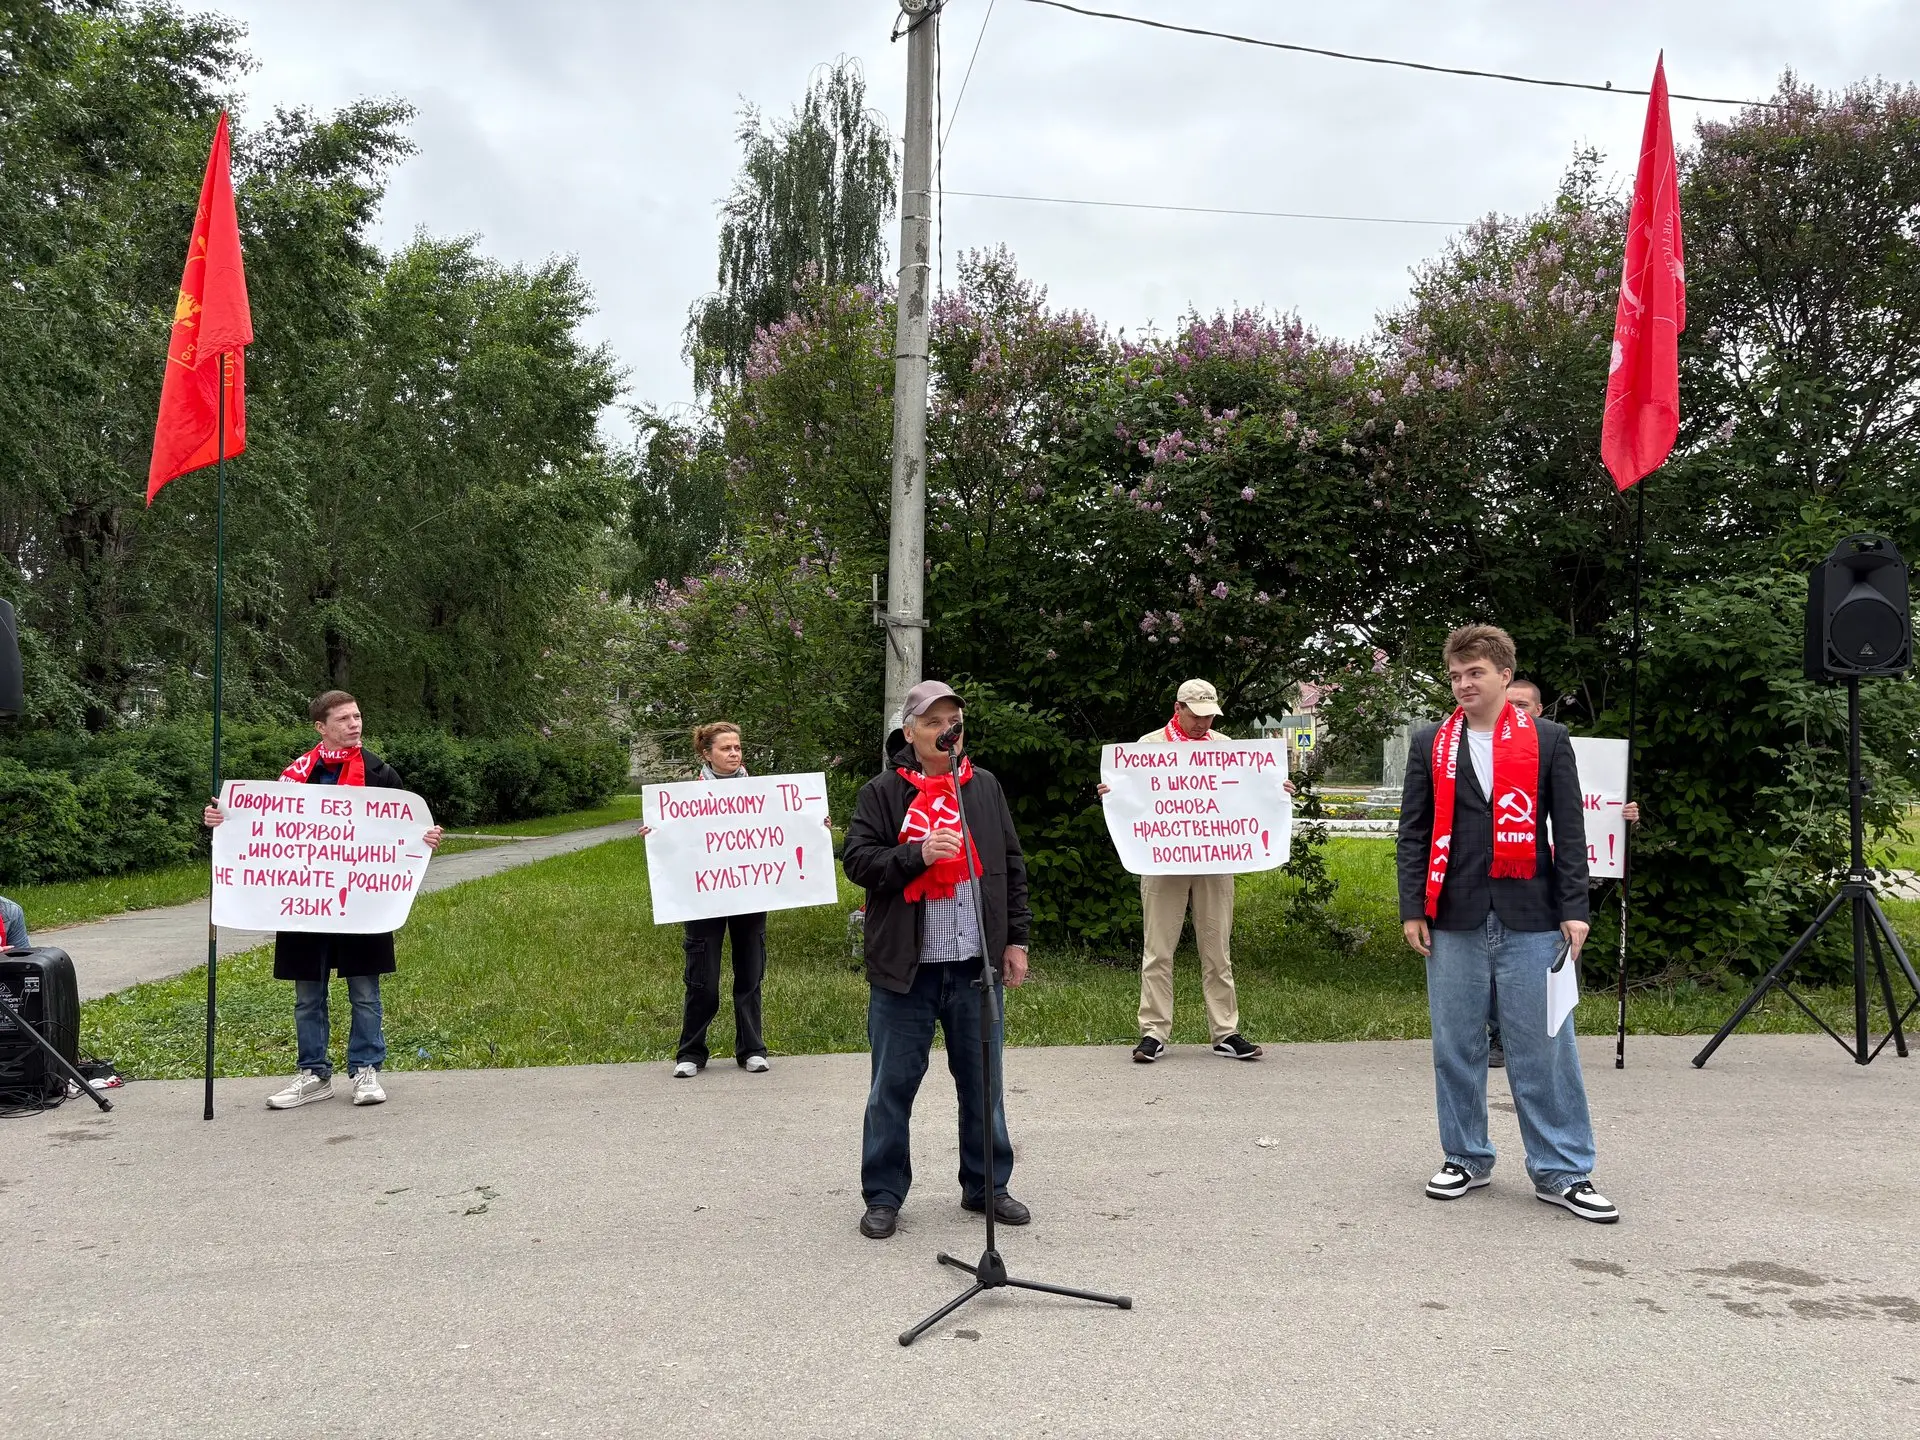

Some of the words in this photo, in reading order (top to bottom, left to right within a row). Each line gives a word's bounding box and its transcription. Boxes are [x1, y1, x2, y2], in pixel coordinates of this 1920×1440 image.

[1189, 751, 1276, 773] ЛИТЕРАТУРА
[1151, 776, 1161, 791] В
[1168, 775, 1218, 791] ШКОЛЕ
[321, 799, 353, 817] БЕЗ
[366, 801, 414, 821] МАТА
[1155, 798, 1220, 815] ОСНОВА
[252, 822, 264, 837] И
[275, 820, 355, 842] КОРЯВОЙ
[706, 826, 784, 853] РУССКУЮ
[1133, 817, 1259, 842] НРАВСТВЕННОГО
[1497, 831, 1534, 843] КПРФ
[215, 866, 234, 886] НЕ
[243, 865, 336, 888] ПАЧКАЙТЕ
[348, 869, 413, 893] РОДНОЙ
